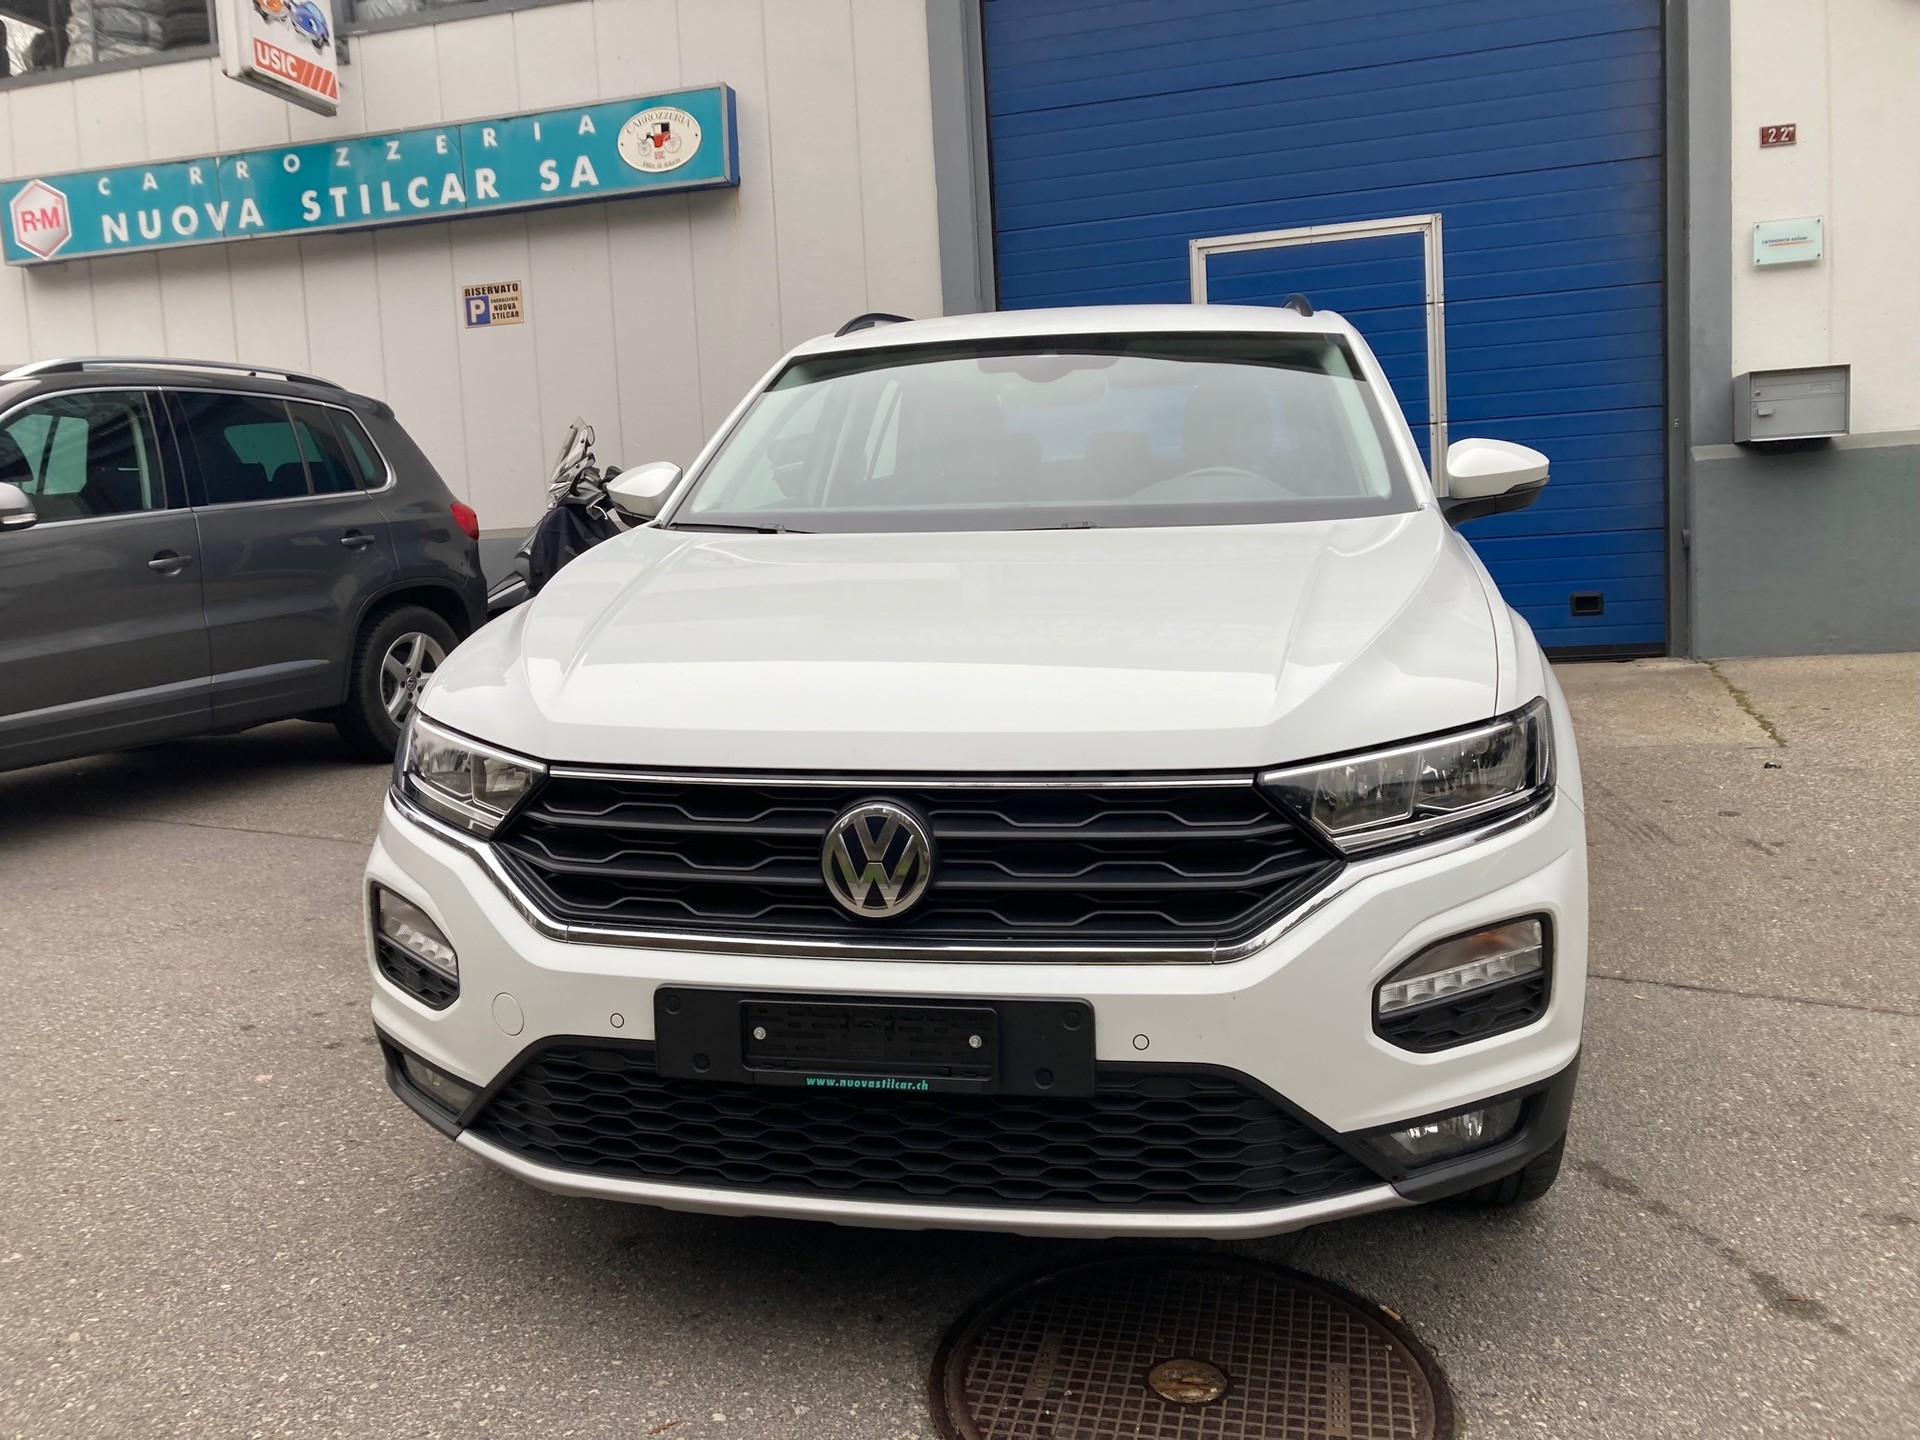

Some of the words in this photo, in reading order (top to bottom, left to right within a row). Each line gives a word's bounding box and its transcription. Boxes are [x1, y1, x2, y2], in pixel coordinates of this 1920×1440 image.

[256, 41, 297, 78] USIC
[627, 112, 690, 134] CARROZZERIA
[97, 114, 596, 196] CARROZZERIA
[101, 198, 264, 244] NUOVA
[301, 167, 500, 222] STILCAR
[539, 155, 599, 192] SA
[21, 206, 61, 232] R-M
[464, 283, 518, 296] RISERVATO
[470, 299, 485, 323] P
[491, 311, 519, 319] STILCAR
[493, 303, 516, 311] NUOVA
[806, 1077, 929, 1091] www.nuovastilcar.ch
